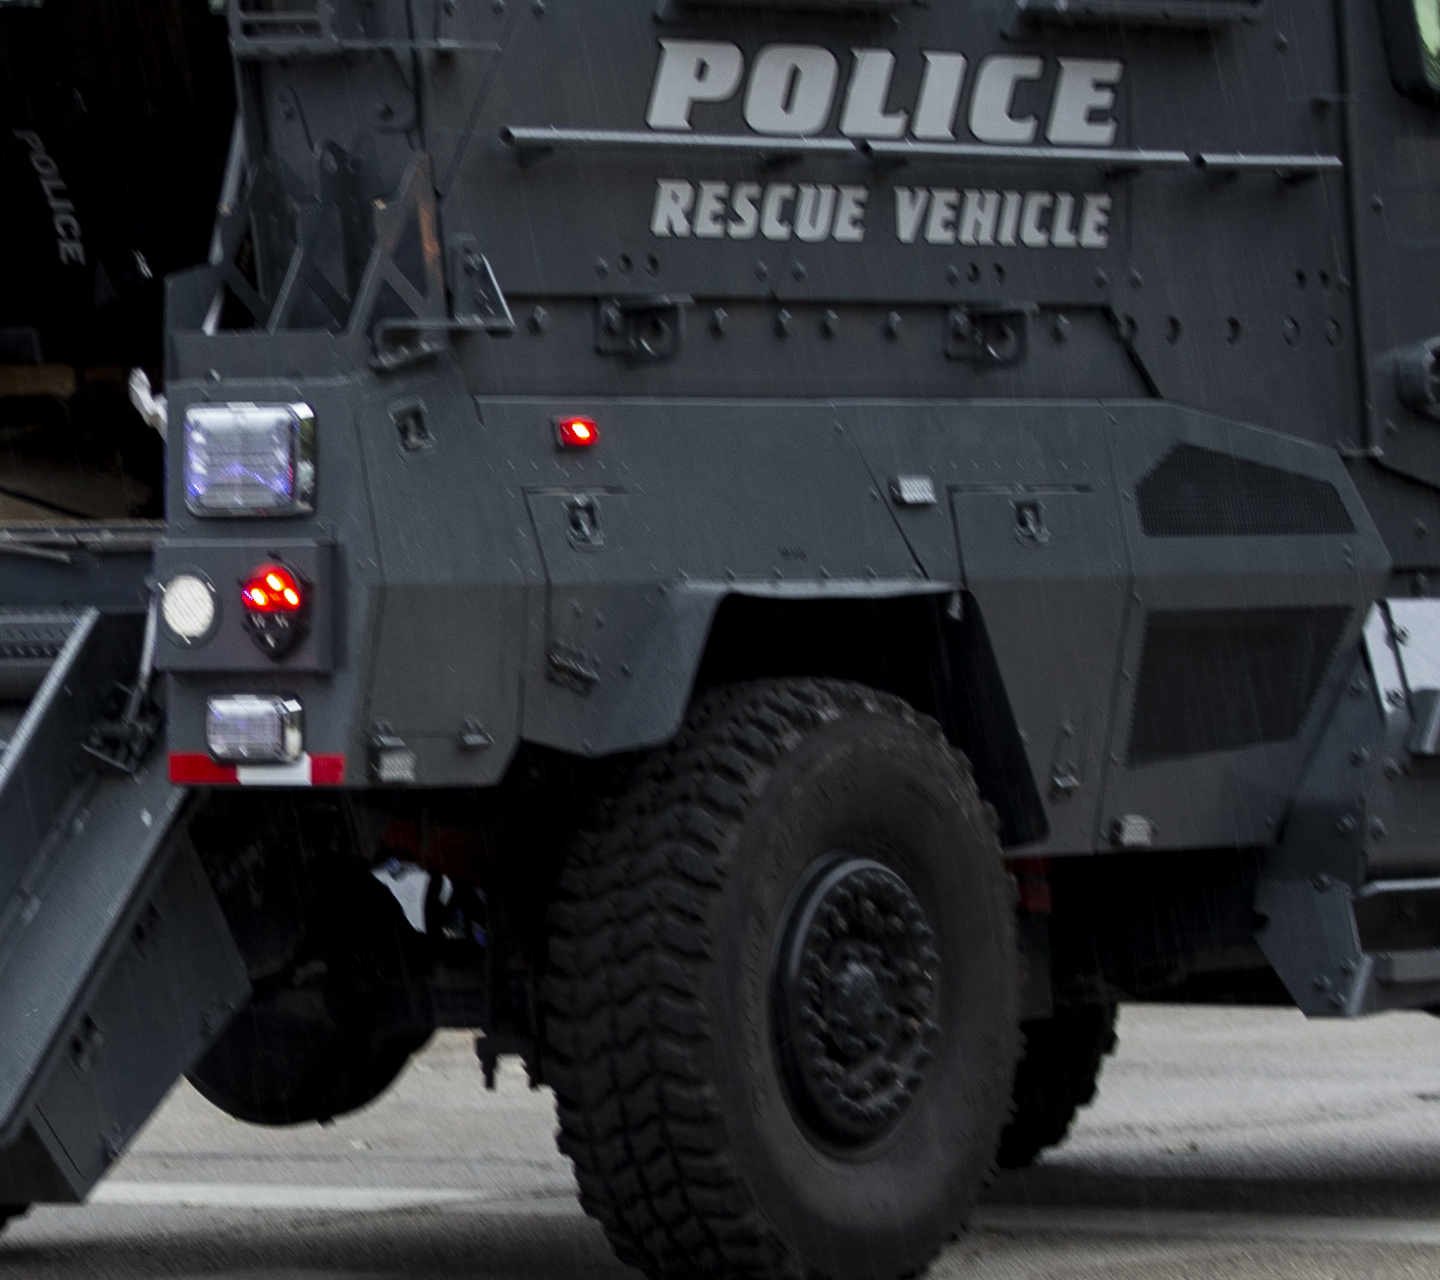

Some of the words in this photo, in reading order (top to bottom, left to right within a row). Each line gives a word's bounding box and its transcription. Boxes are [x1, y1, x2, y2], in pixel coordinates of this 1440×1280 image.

[646, 38, 1124, 147] POLICE
[11, 128, 87, 266] POLICE
[650, 178, 868, 244] RESCUE
[894, 186, 1112, 249] VEHICLE
